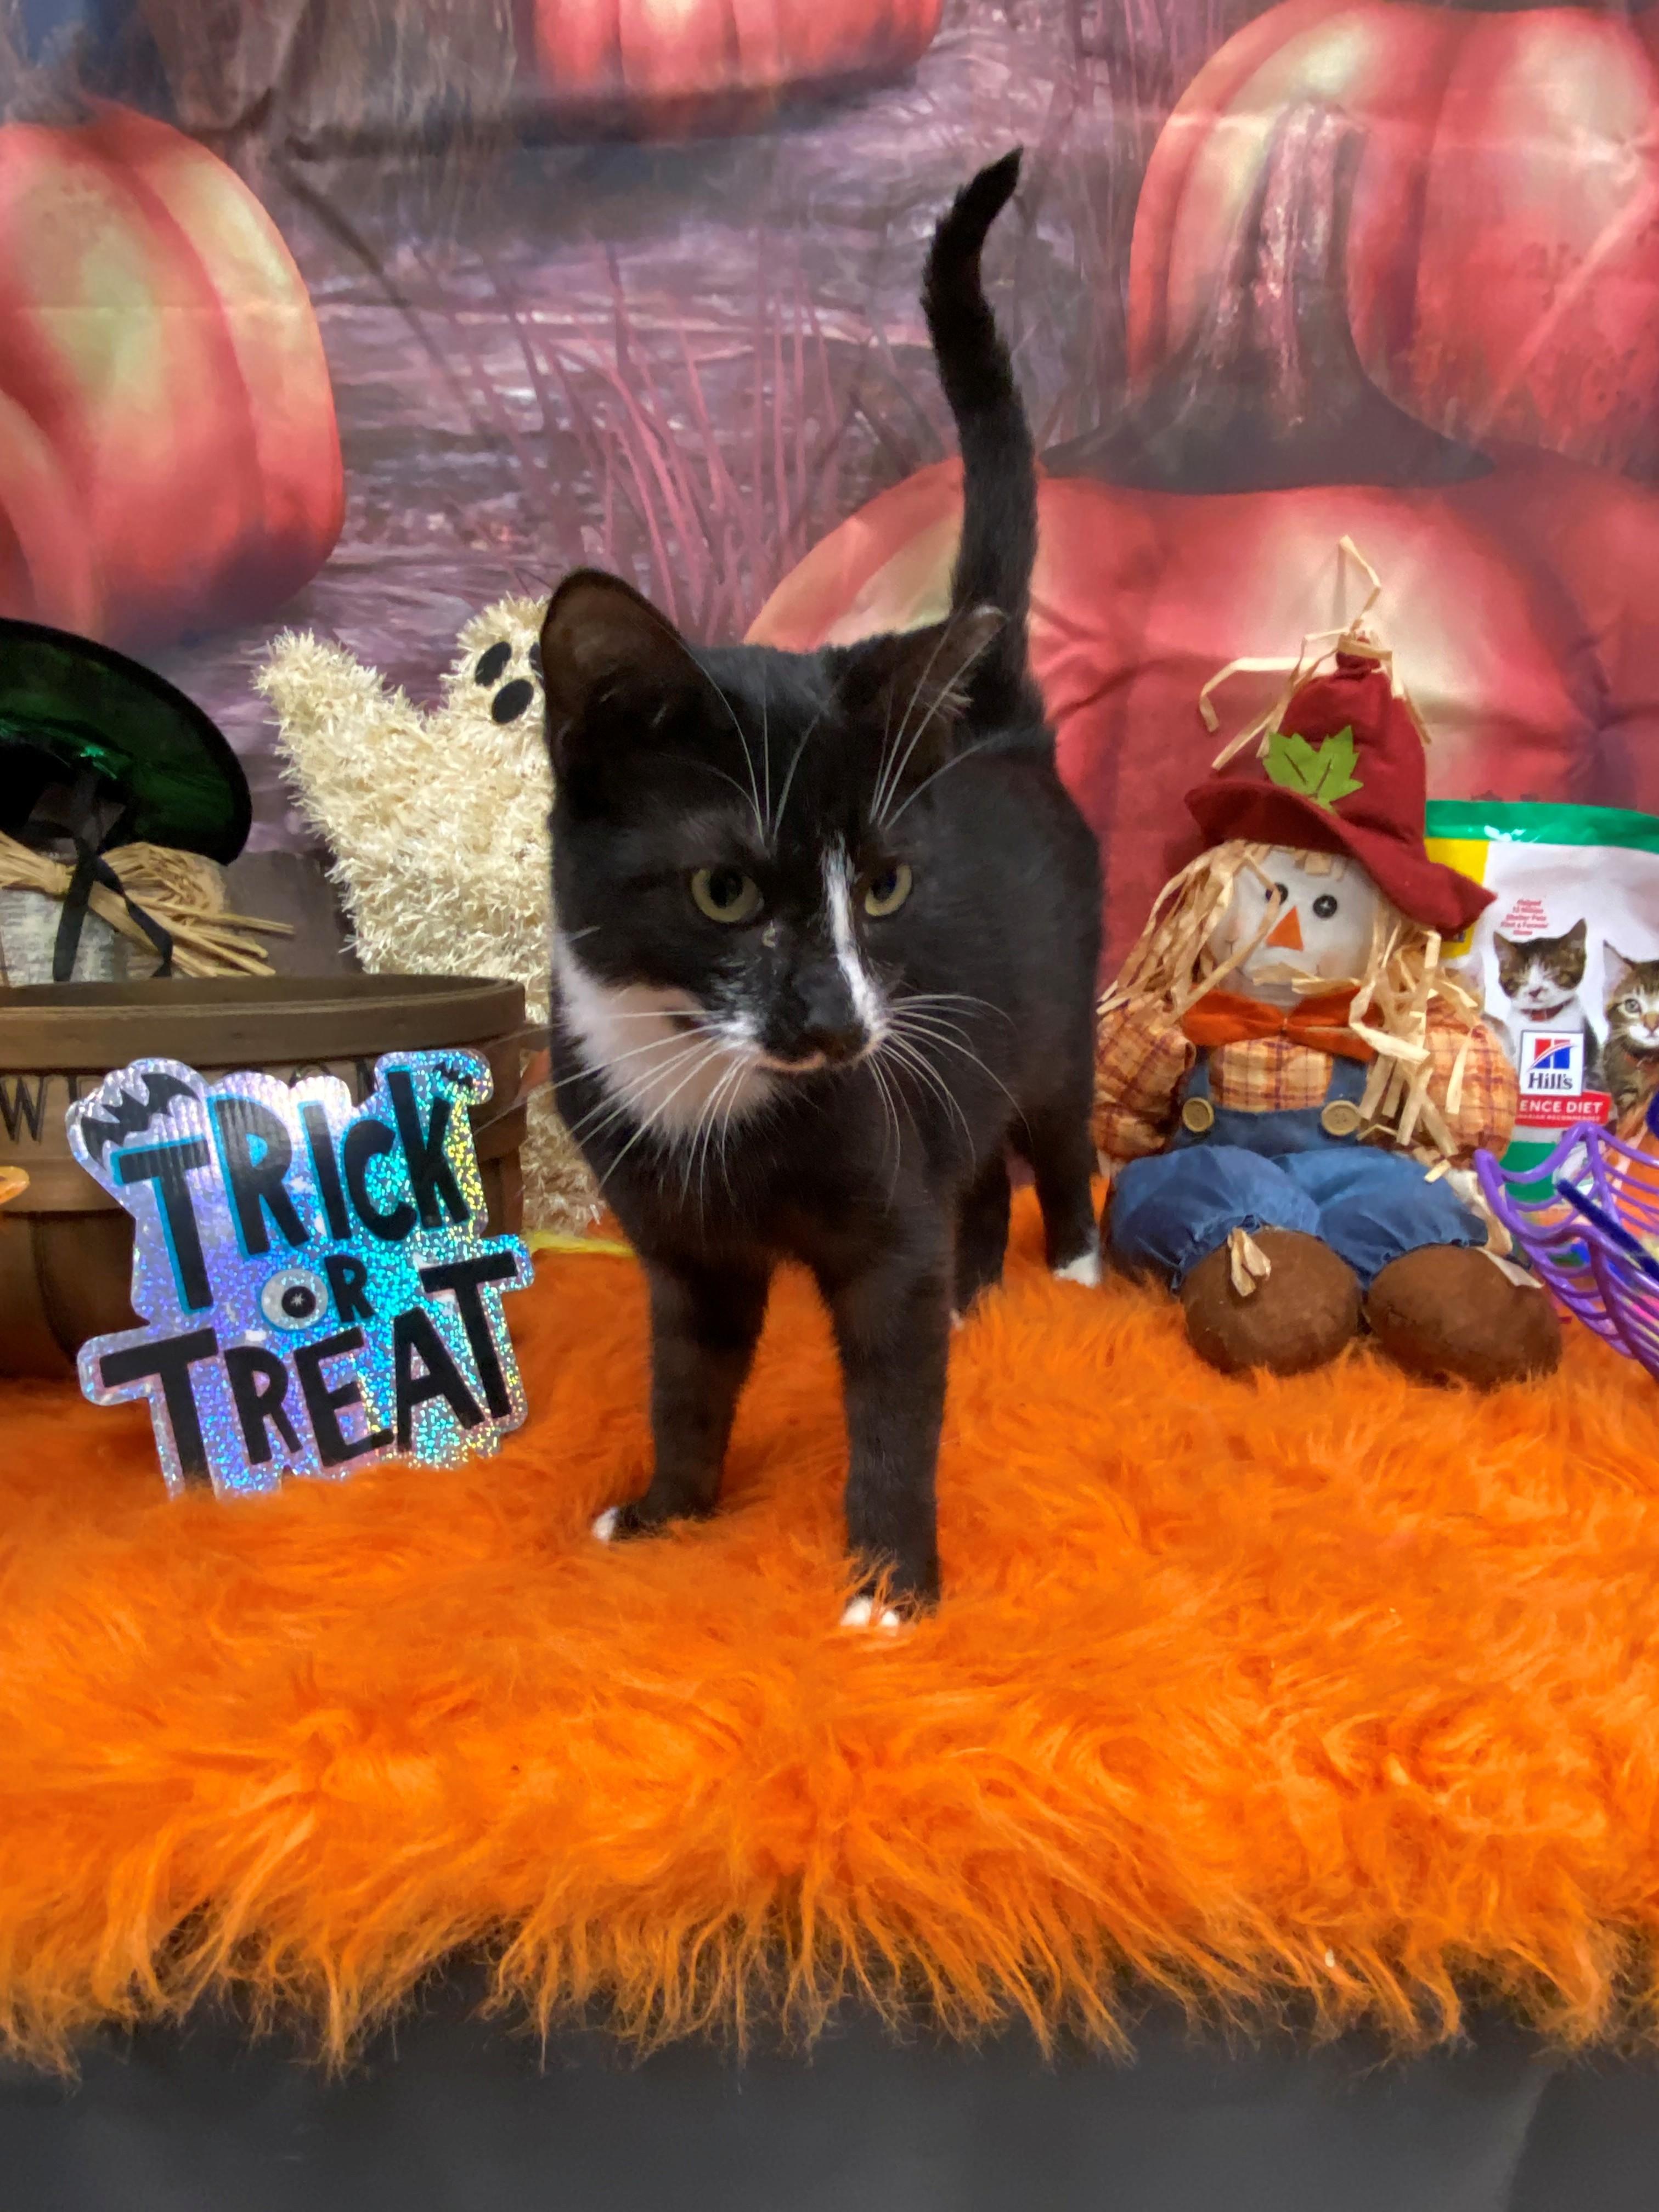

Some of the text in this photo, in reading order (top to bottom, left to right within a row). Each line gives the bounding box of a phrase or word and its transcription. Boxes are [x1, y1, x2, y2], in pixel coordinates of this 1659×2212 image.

[1528, 1072, 1573, 1090] Hill's
[1566, 1102, 1604, 1114] DIET
[112, 1068, 471, 1312] TRICK
[99, 1250, 518, 1486] TREAT
